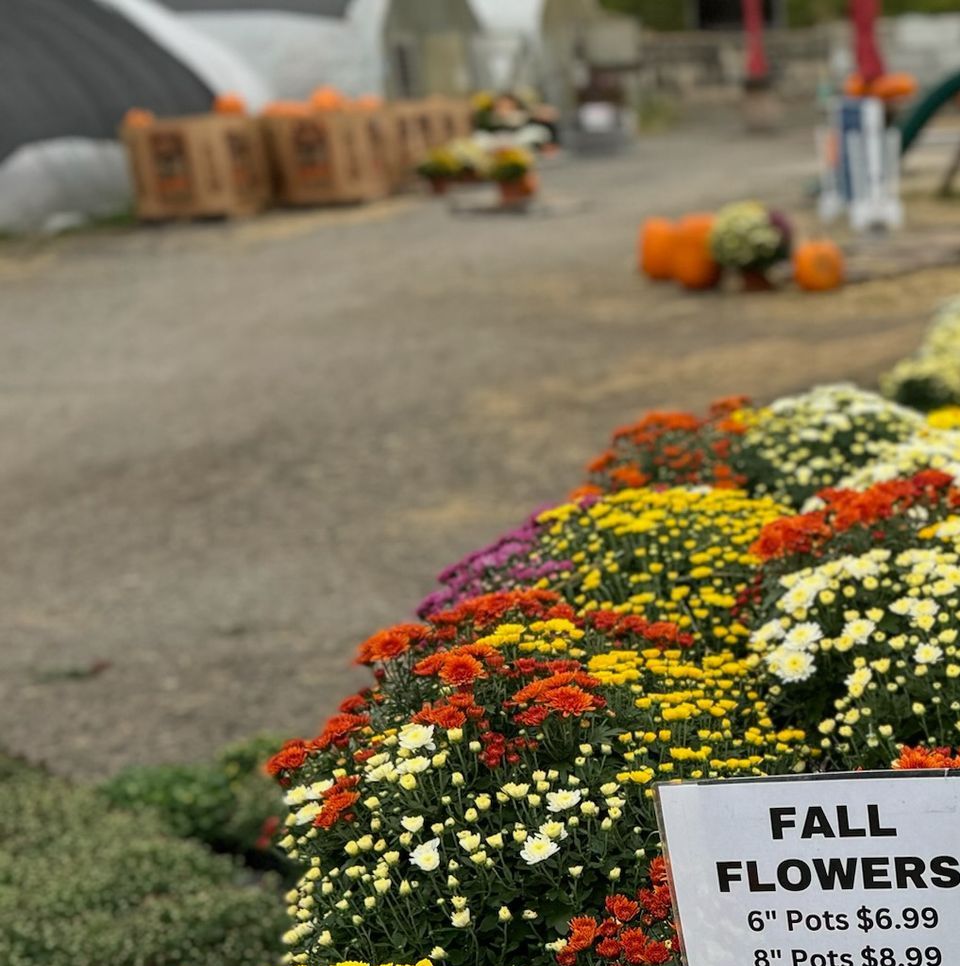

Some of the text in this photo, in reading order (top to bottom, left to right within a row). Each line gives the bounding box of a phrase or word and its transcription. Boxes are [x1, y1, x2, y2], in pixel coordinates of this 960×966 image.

[769, 804, 897, 839] FALL
[716, 856, 960, 892] FLOWERS
[748, 906, 939, 932] 6" Pots $6.99
